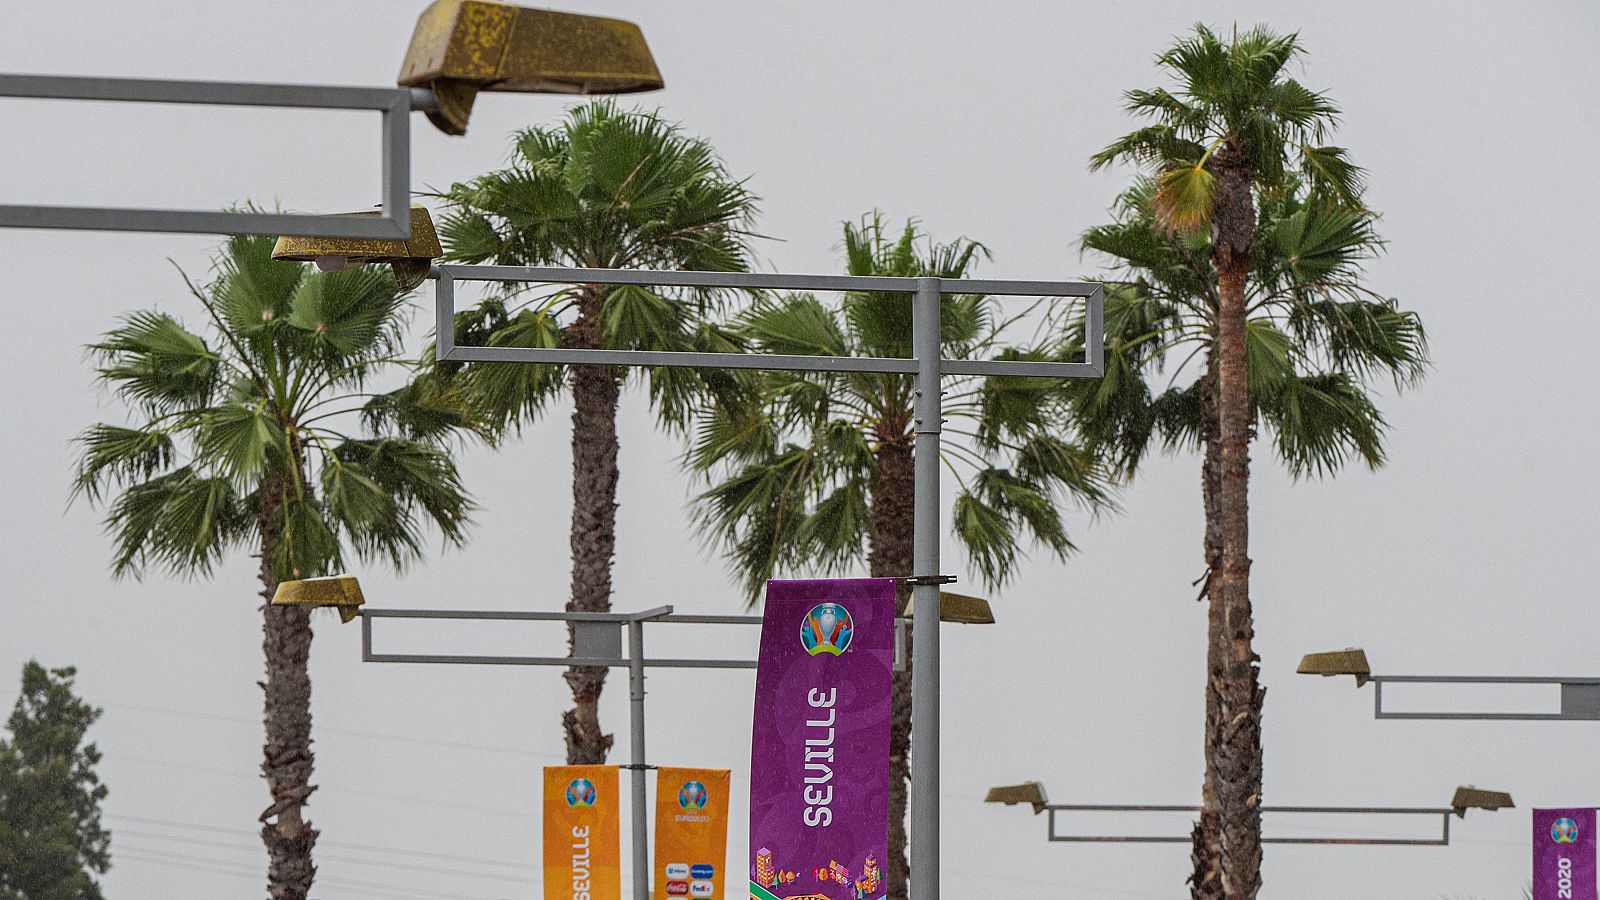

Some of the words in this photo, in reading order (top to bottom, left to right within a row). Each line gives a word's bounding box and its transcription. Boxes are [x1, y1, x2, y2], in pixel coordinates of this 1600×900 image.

[803, 687, 837, 827] SEVILLE
[572, 825, 591, 900] SEVILLE
[1557, 857, 1572, 899] 2020
